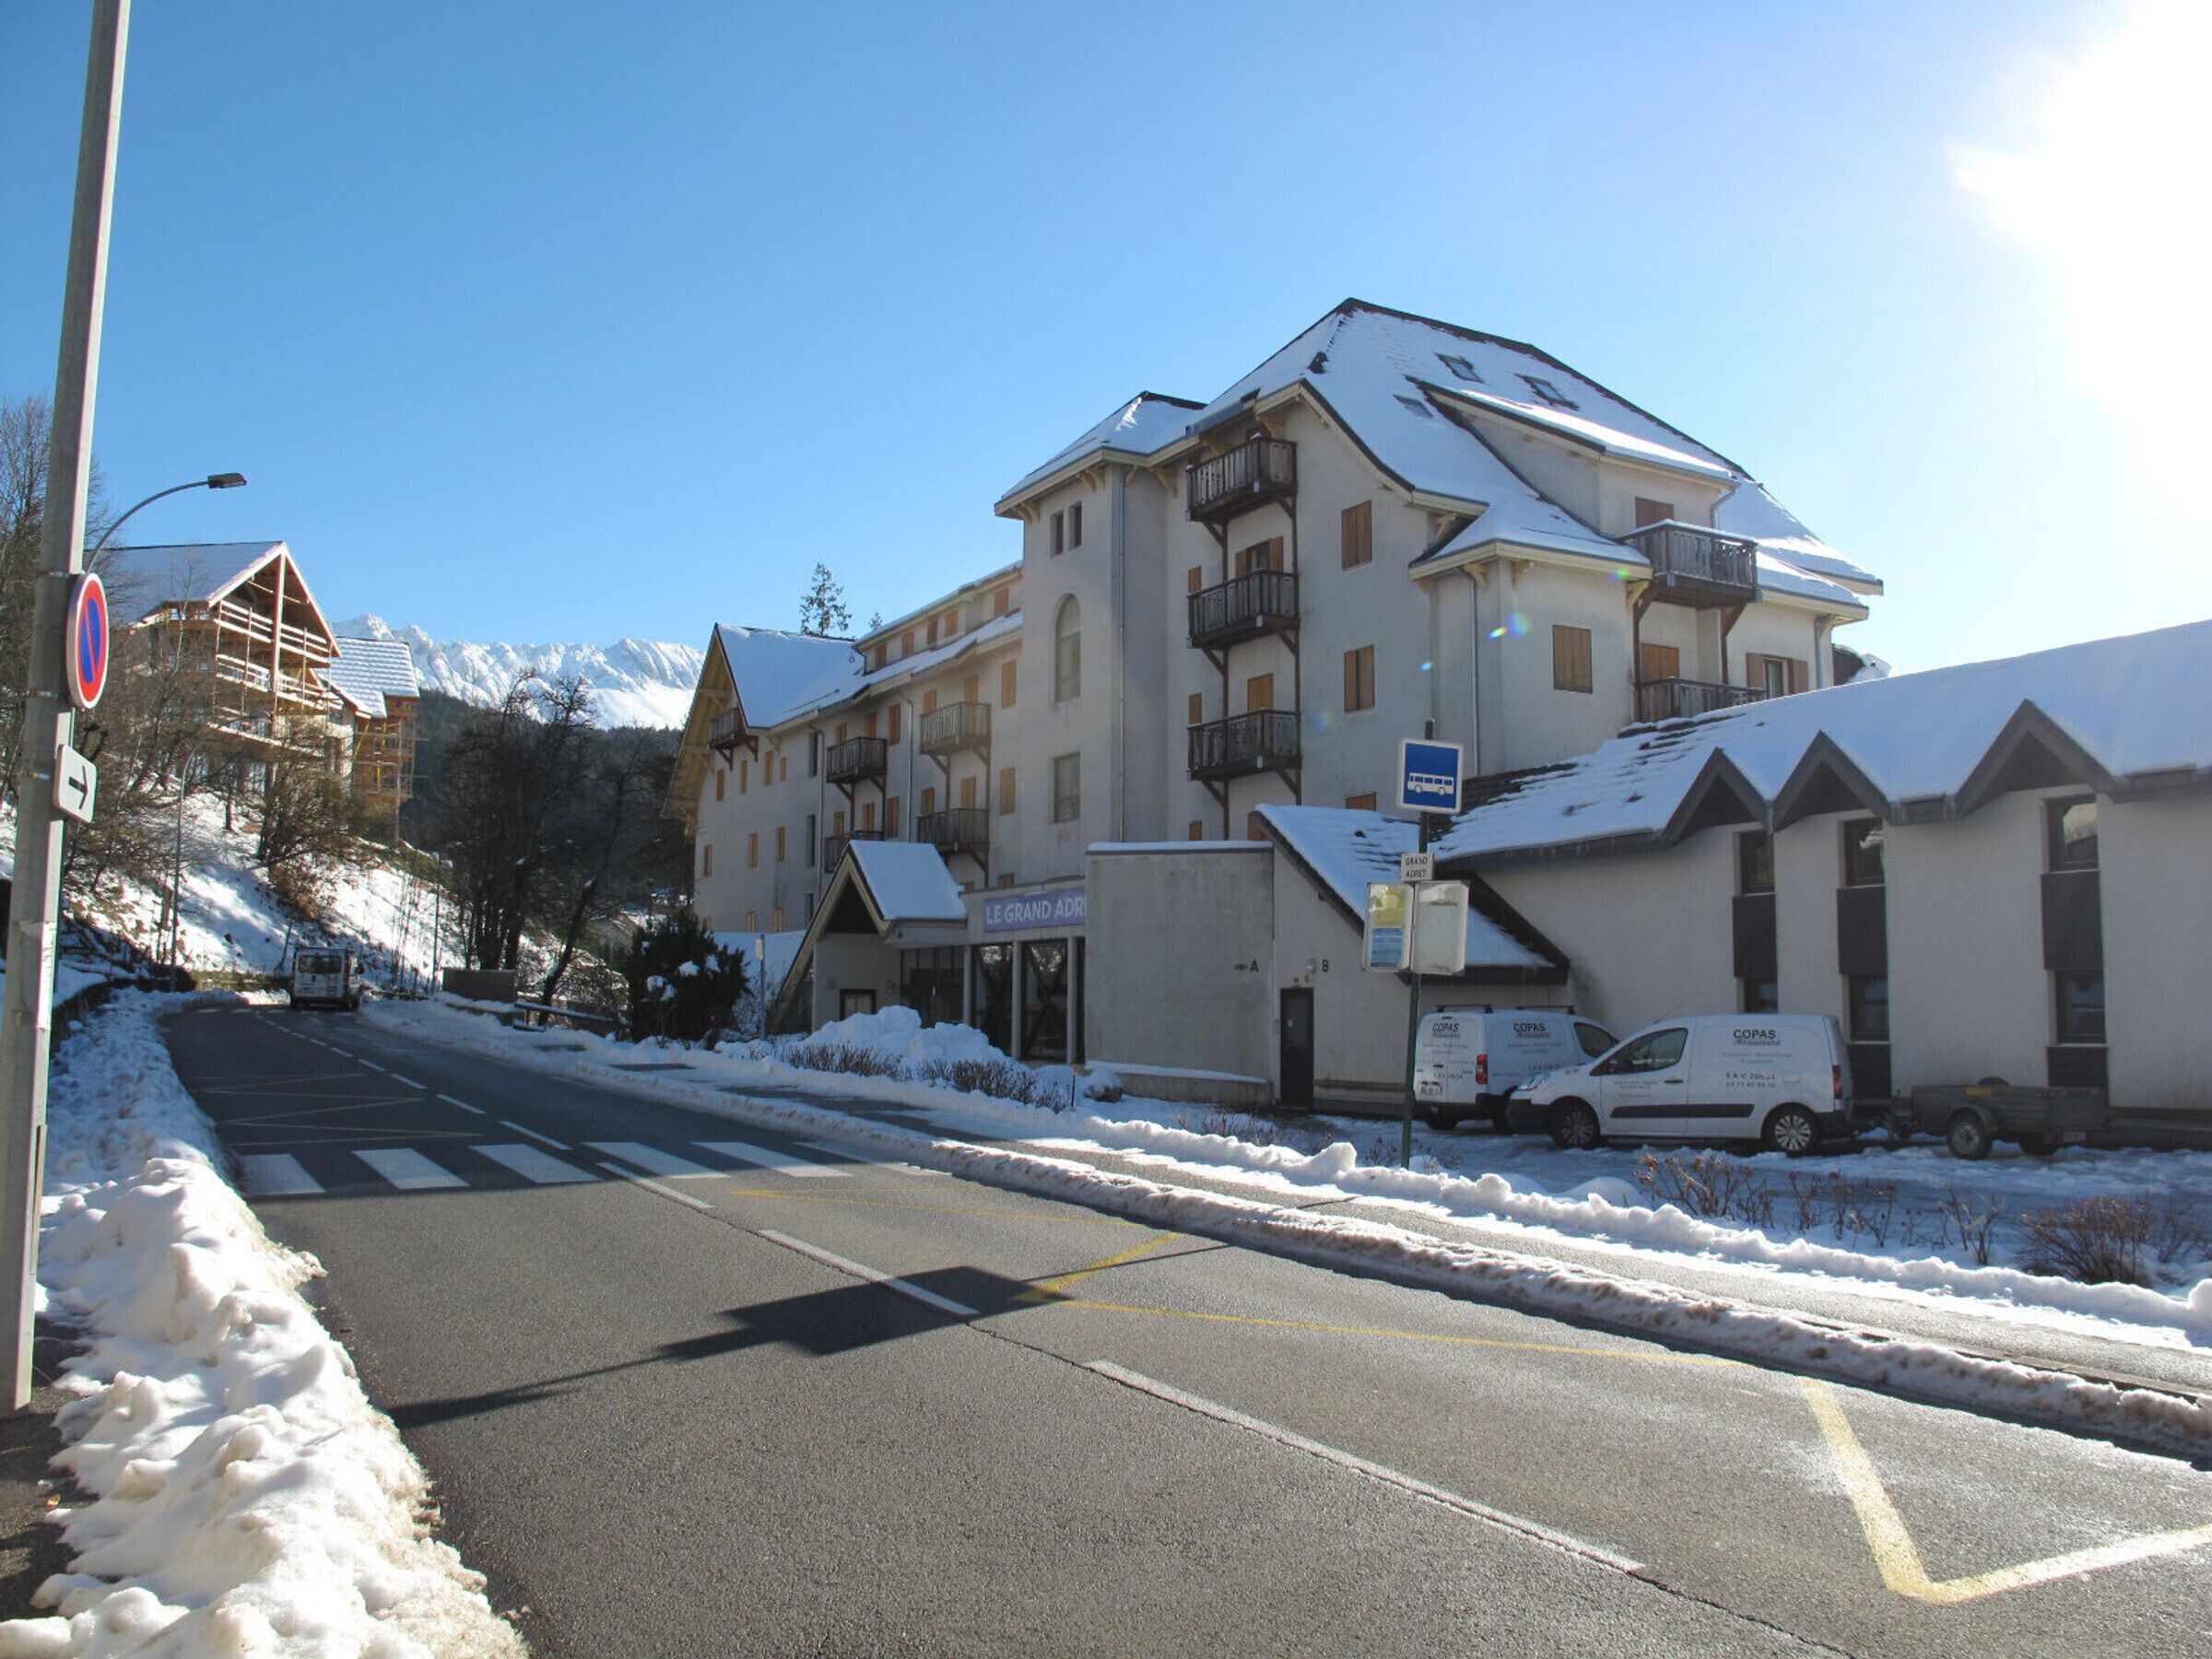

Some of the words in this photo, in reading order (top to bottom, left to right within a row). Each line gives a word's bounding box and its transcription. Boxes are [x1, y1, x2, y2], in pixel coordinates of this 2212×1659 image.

[1406, 856, 1428, 866] GRAND
[1406, 869, 1427, 878] ADRET
[986, 904, 1003, 925] LE
[1004, 900, 1053, 924] GRAND
[1249, 959, 1260, 973] A
[1432, 1022, 1460, 1032] COPAS
[1513, 1022, 1546, 1032] COPAS
[1733, 1029, 1776, 1040] COPAS
